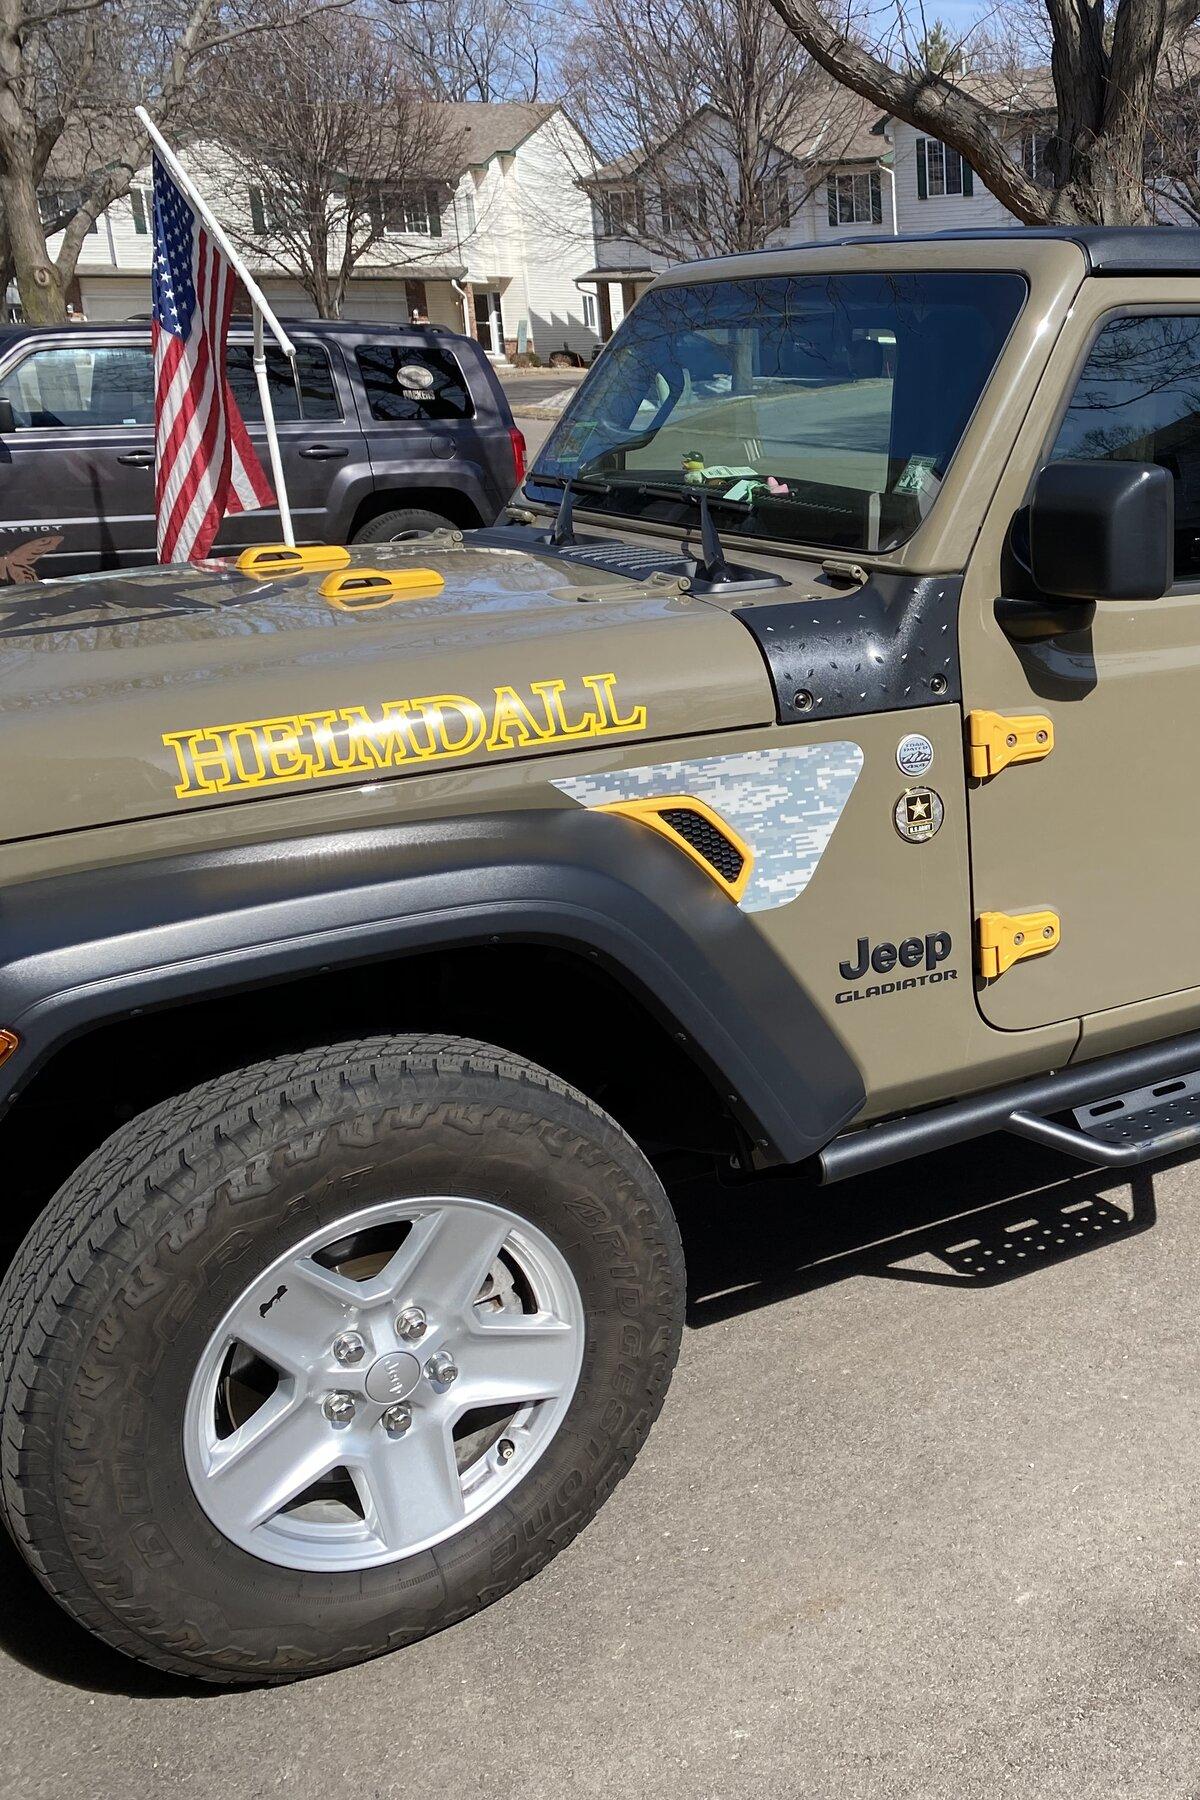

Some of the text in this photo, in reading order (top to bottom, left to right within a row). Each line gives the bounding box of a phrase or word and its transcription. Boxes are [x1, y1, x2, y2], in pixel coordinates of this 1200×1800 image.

[161, 672, 648, 799] HEIMDALL
[838, 930, 952, 980] Jeep
[834, 969, 958, 1004] GLADIATOR
